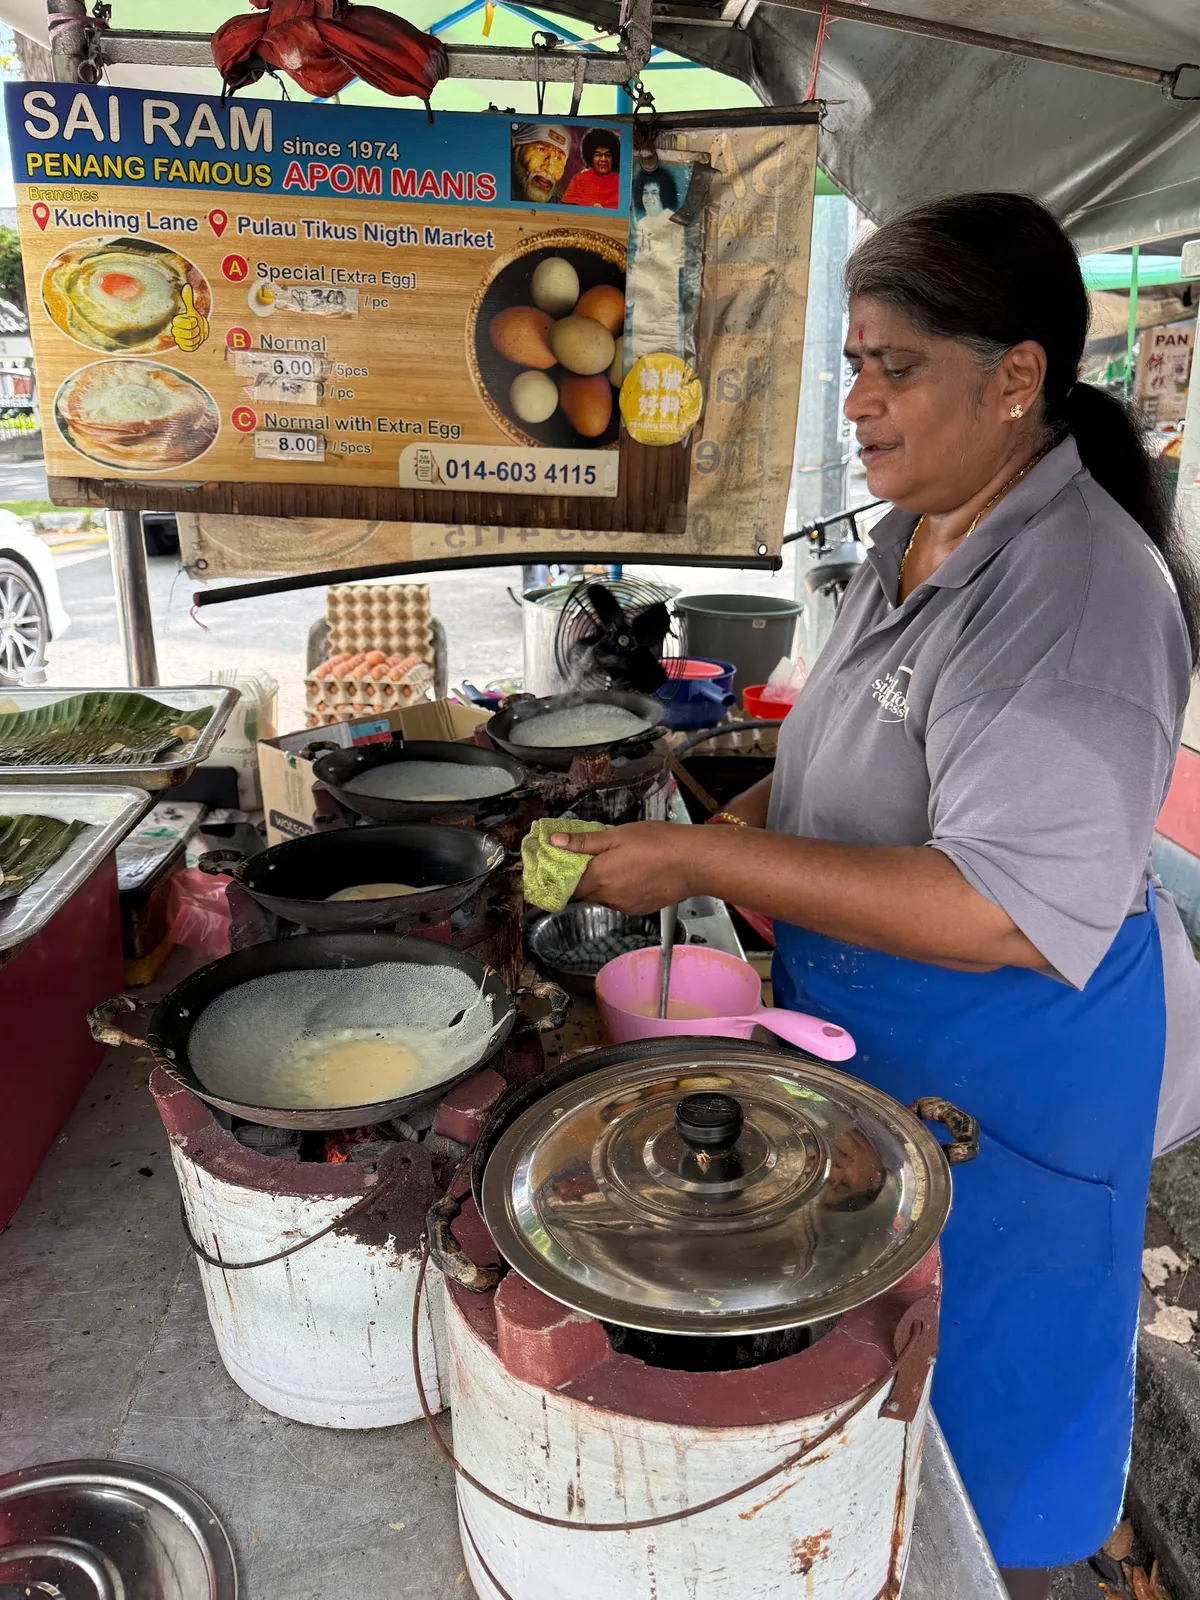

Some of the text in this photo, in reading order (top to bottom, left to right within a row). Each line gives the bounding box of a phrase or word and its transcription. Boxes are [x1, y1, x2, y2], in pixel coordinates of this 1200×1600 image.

[23, 90, 274, 153] SAI RAM
[282, 136, 400, 161] since 1974
[26, 152, 497, 201] PENANG FAMOUS APOM MANIS
[28, 186, 99, 202] Branches
[54, 208, 199, 233] Kuching Lane
[237, 216, 496, 249] Pulau Tikus Nigth Market
[228, 260, 416, 289] A Special [Extra Egg]
[232, 333, 326, 352] B Normal
[1155, 334, 1189, 347] PAN
[273, 359, 312, 376] 6.00
[237, 413, 461, 439] C Normal with Extra Egg
[278, 437, 316, 453] 8.00
[445, 459, 537, 482] 014-603
[544, 464, 597, 485] 4115
